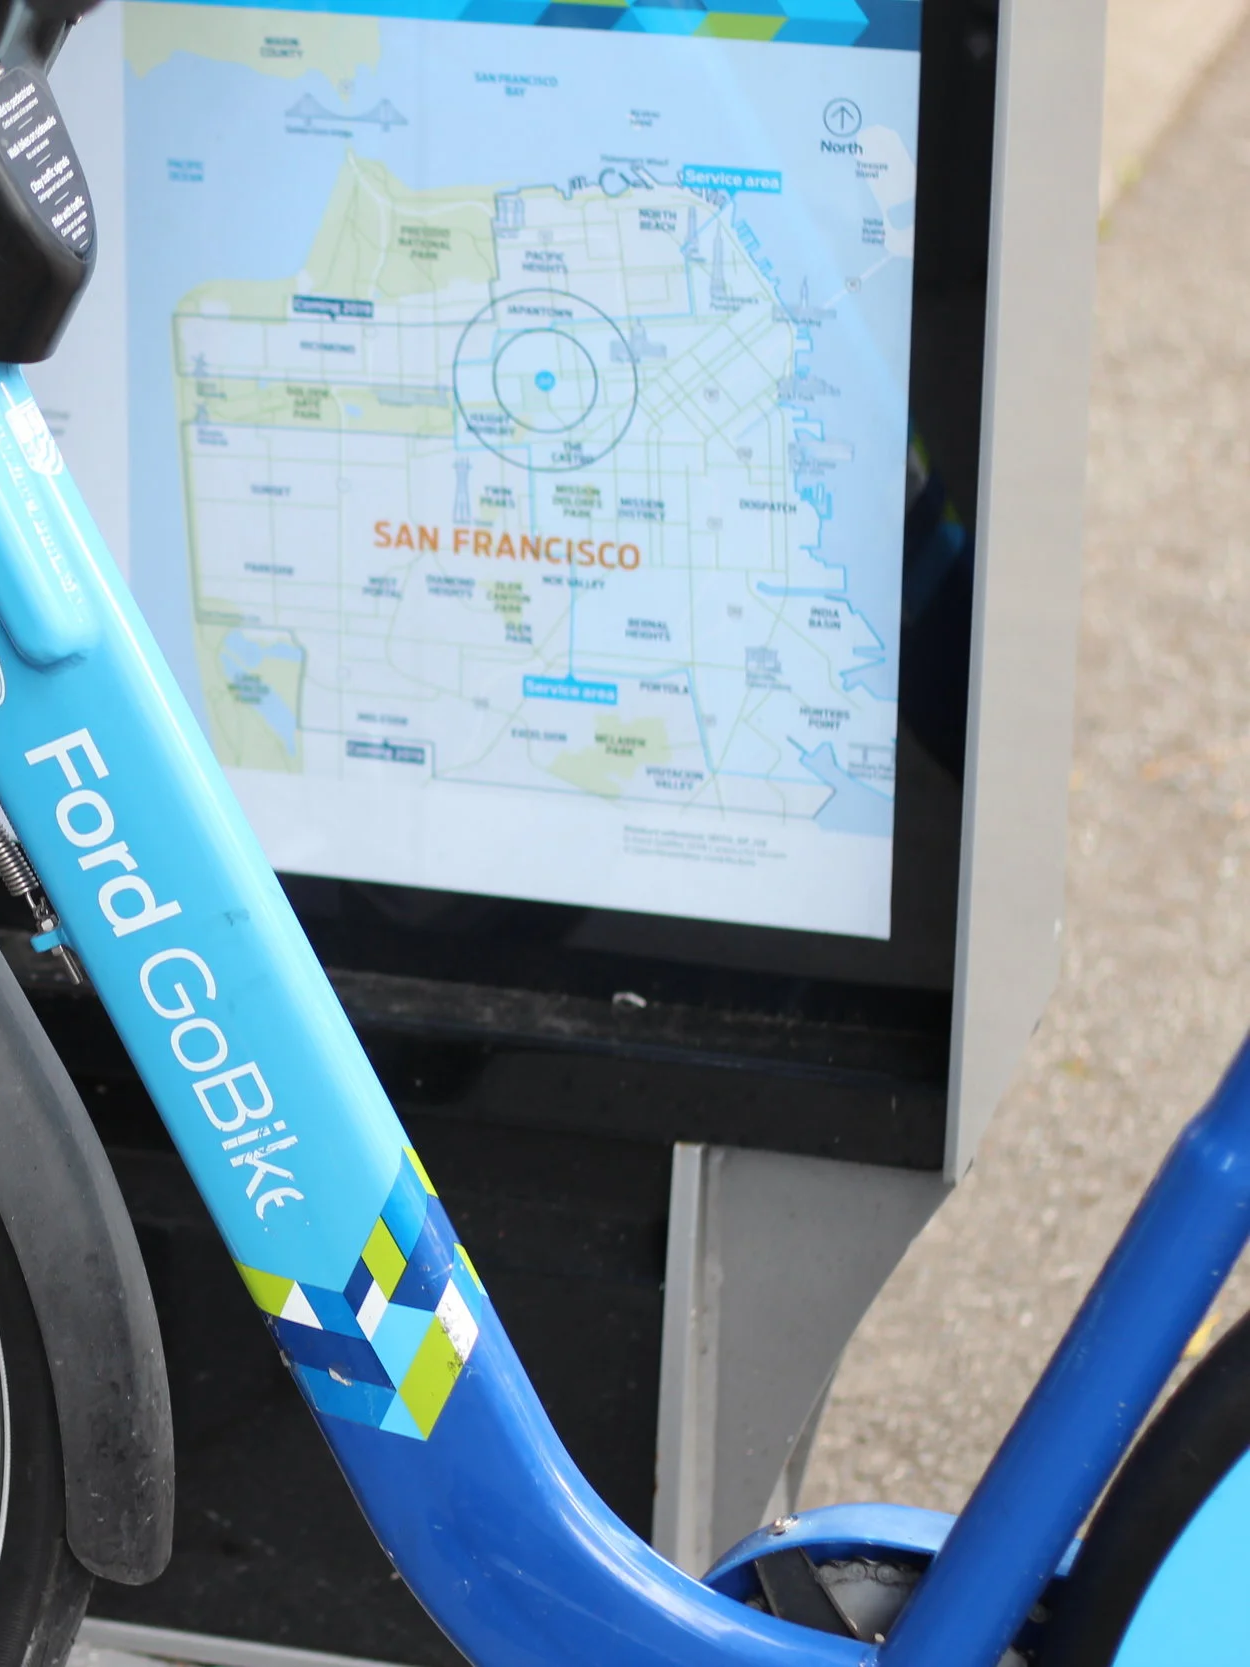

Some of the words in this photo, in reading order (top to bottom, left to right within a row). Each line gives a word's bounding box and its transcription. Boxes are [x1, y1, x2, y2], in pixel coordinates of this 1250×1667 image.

[474, 71, 496, 84] SAN
[498, 73, 558, 88] FRANCISCO
[505, 85, 526, 98] BAY
[820, 139, 864, 155] North
[685, 168, 743, 187] Service
[744, 175, 781, 190] area
[638, 207, 677, 221] NORTH
[639, 219, 677, 233] BEACH
[398, 237, 452, 251] NATIONAL
[410, 249, 438, 261] PARK
[524, 250, 565, 263] PACIFIC
[521, 262, 569, 275] HEIGHTS
[507, 304, 574, 319] JAPANTOWN
[563, 441, 582, 452] THE
[484, 485, 513, 498] TWIN
[555, 484, 601, 497] MISSION
[479, 496, 516, 510] PEAKS
[552, 496, 602, 510] DOLORES
[619, 497, 665, 511] MISSION
[738, 499, 798, 515] DOGPATCH
[562, 508, 591, 520] PARK
[617, 508, 665, 522] DISTRICT
[373, 520, 439, 553] SAN
[452, 528, 641, 572] FRANCISCO
[425, 574, 476, 588] DIAMOND
[494, 580, 522, 592] GLEN
[542, 575, 564, 587] NOE
[567, 577, 606, 591] VALLEY
[427, 586, 474, 600] HEIGHTS
[486, 591, 530, 604] CANYON
[494, 602, 523, 614] PARK
[809, 606, 840, 619] INDIA
[504, 622, 533, 634] GLEN
[627, 617, 669, 631] BERNAL
[808, 618, 842, 631] BASIN
[505, 633, 533, 645] PARK
[624, 629, 672, 643] HEIGHTS
[526, 679, 581, 697] Service
[582, 686, 617, 702] area
[639, 680, 690, 695] PORTOLA
[799, 706, 851, 720] HUNTERS
[808, 718, 842, 732] POINT
[605, 745, 634, 757] PARK
[645, 766, 705, 781] VISITACION
[654, 778, 695, 791] VALLEY
[23, 727, 183, 938] Ford
[139, 948, 306, 1222] GoBike
